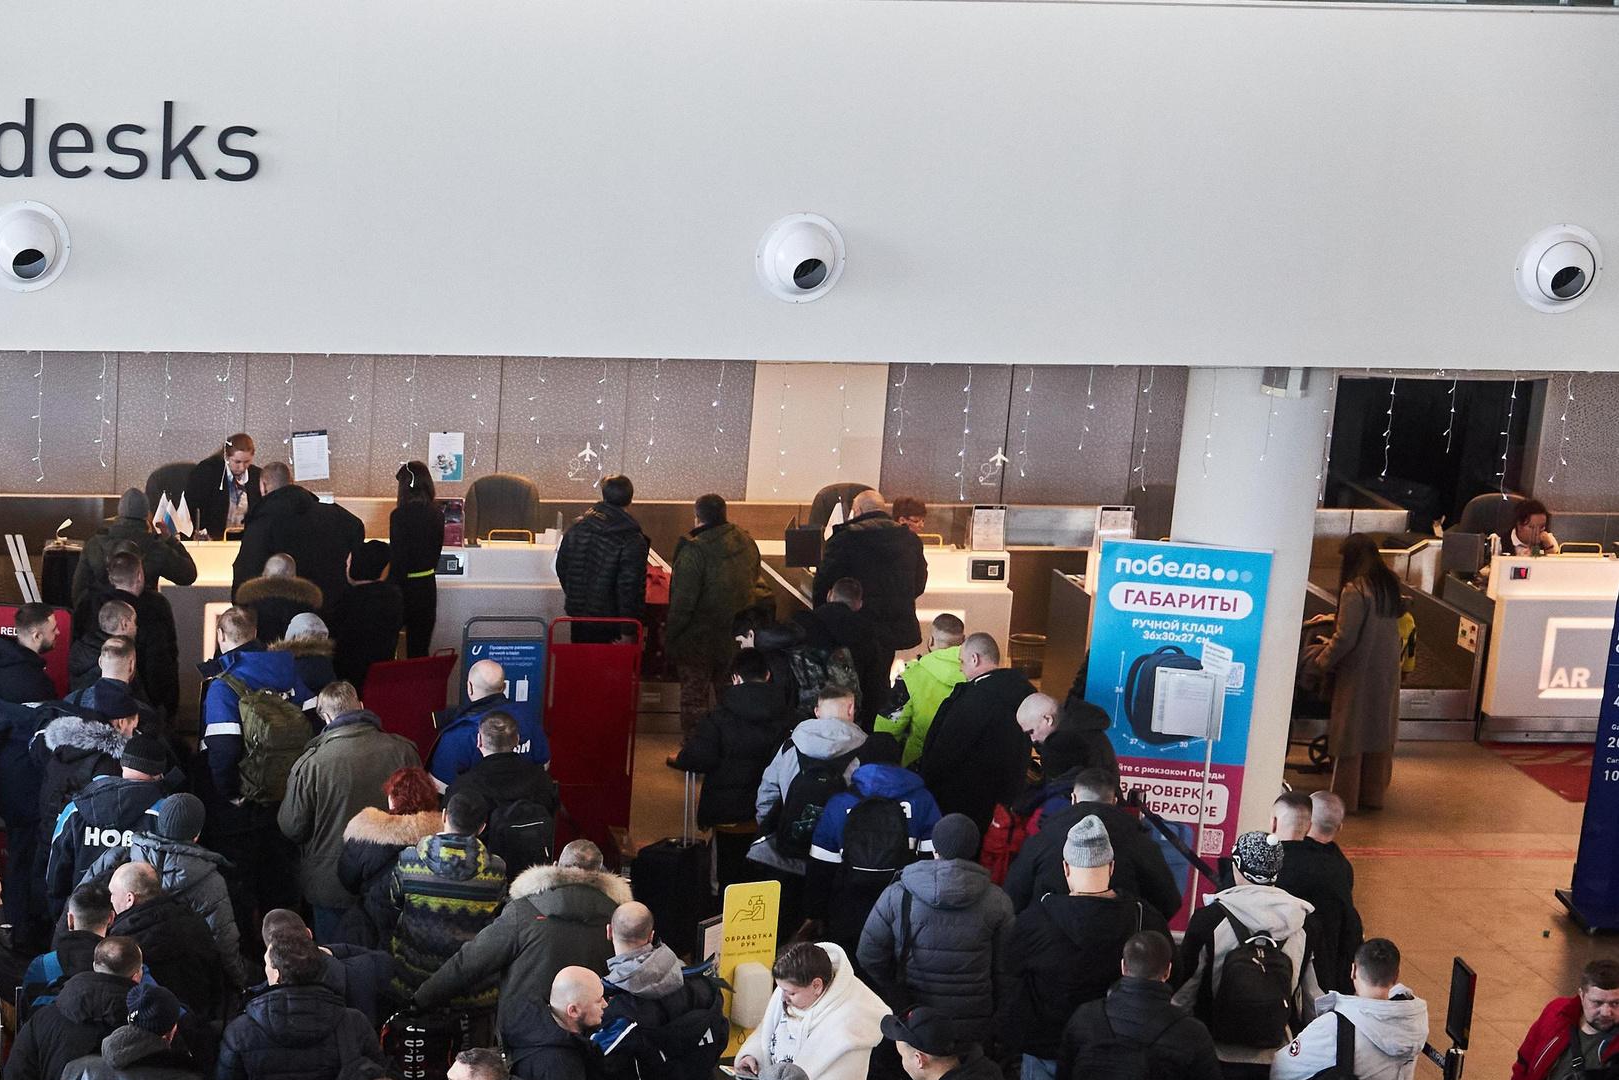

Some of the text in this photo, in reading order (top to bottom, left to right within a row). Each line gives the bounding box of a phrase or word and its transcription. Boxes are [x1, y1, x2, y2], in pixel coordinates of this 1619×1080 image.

[1115, 555, 1210, 580] победа
[1124, 589, 1238, 612] ГАБАРИТЫ
[1132, 618, 1223, 635] РУЧНОЙ КЛАДИ
[1189, 769, 1225, 779] Побды
[84, 826, 134, 848] НОВ
[725, 933, 772, 942] ОБРАБОТКА
